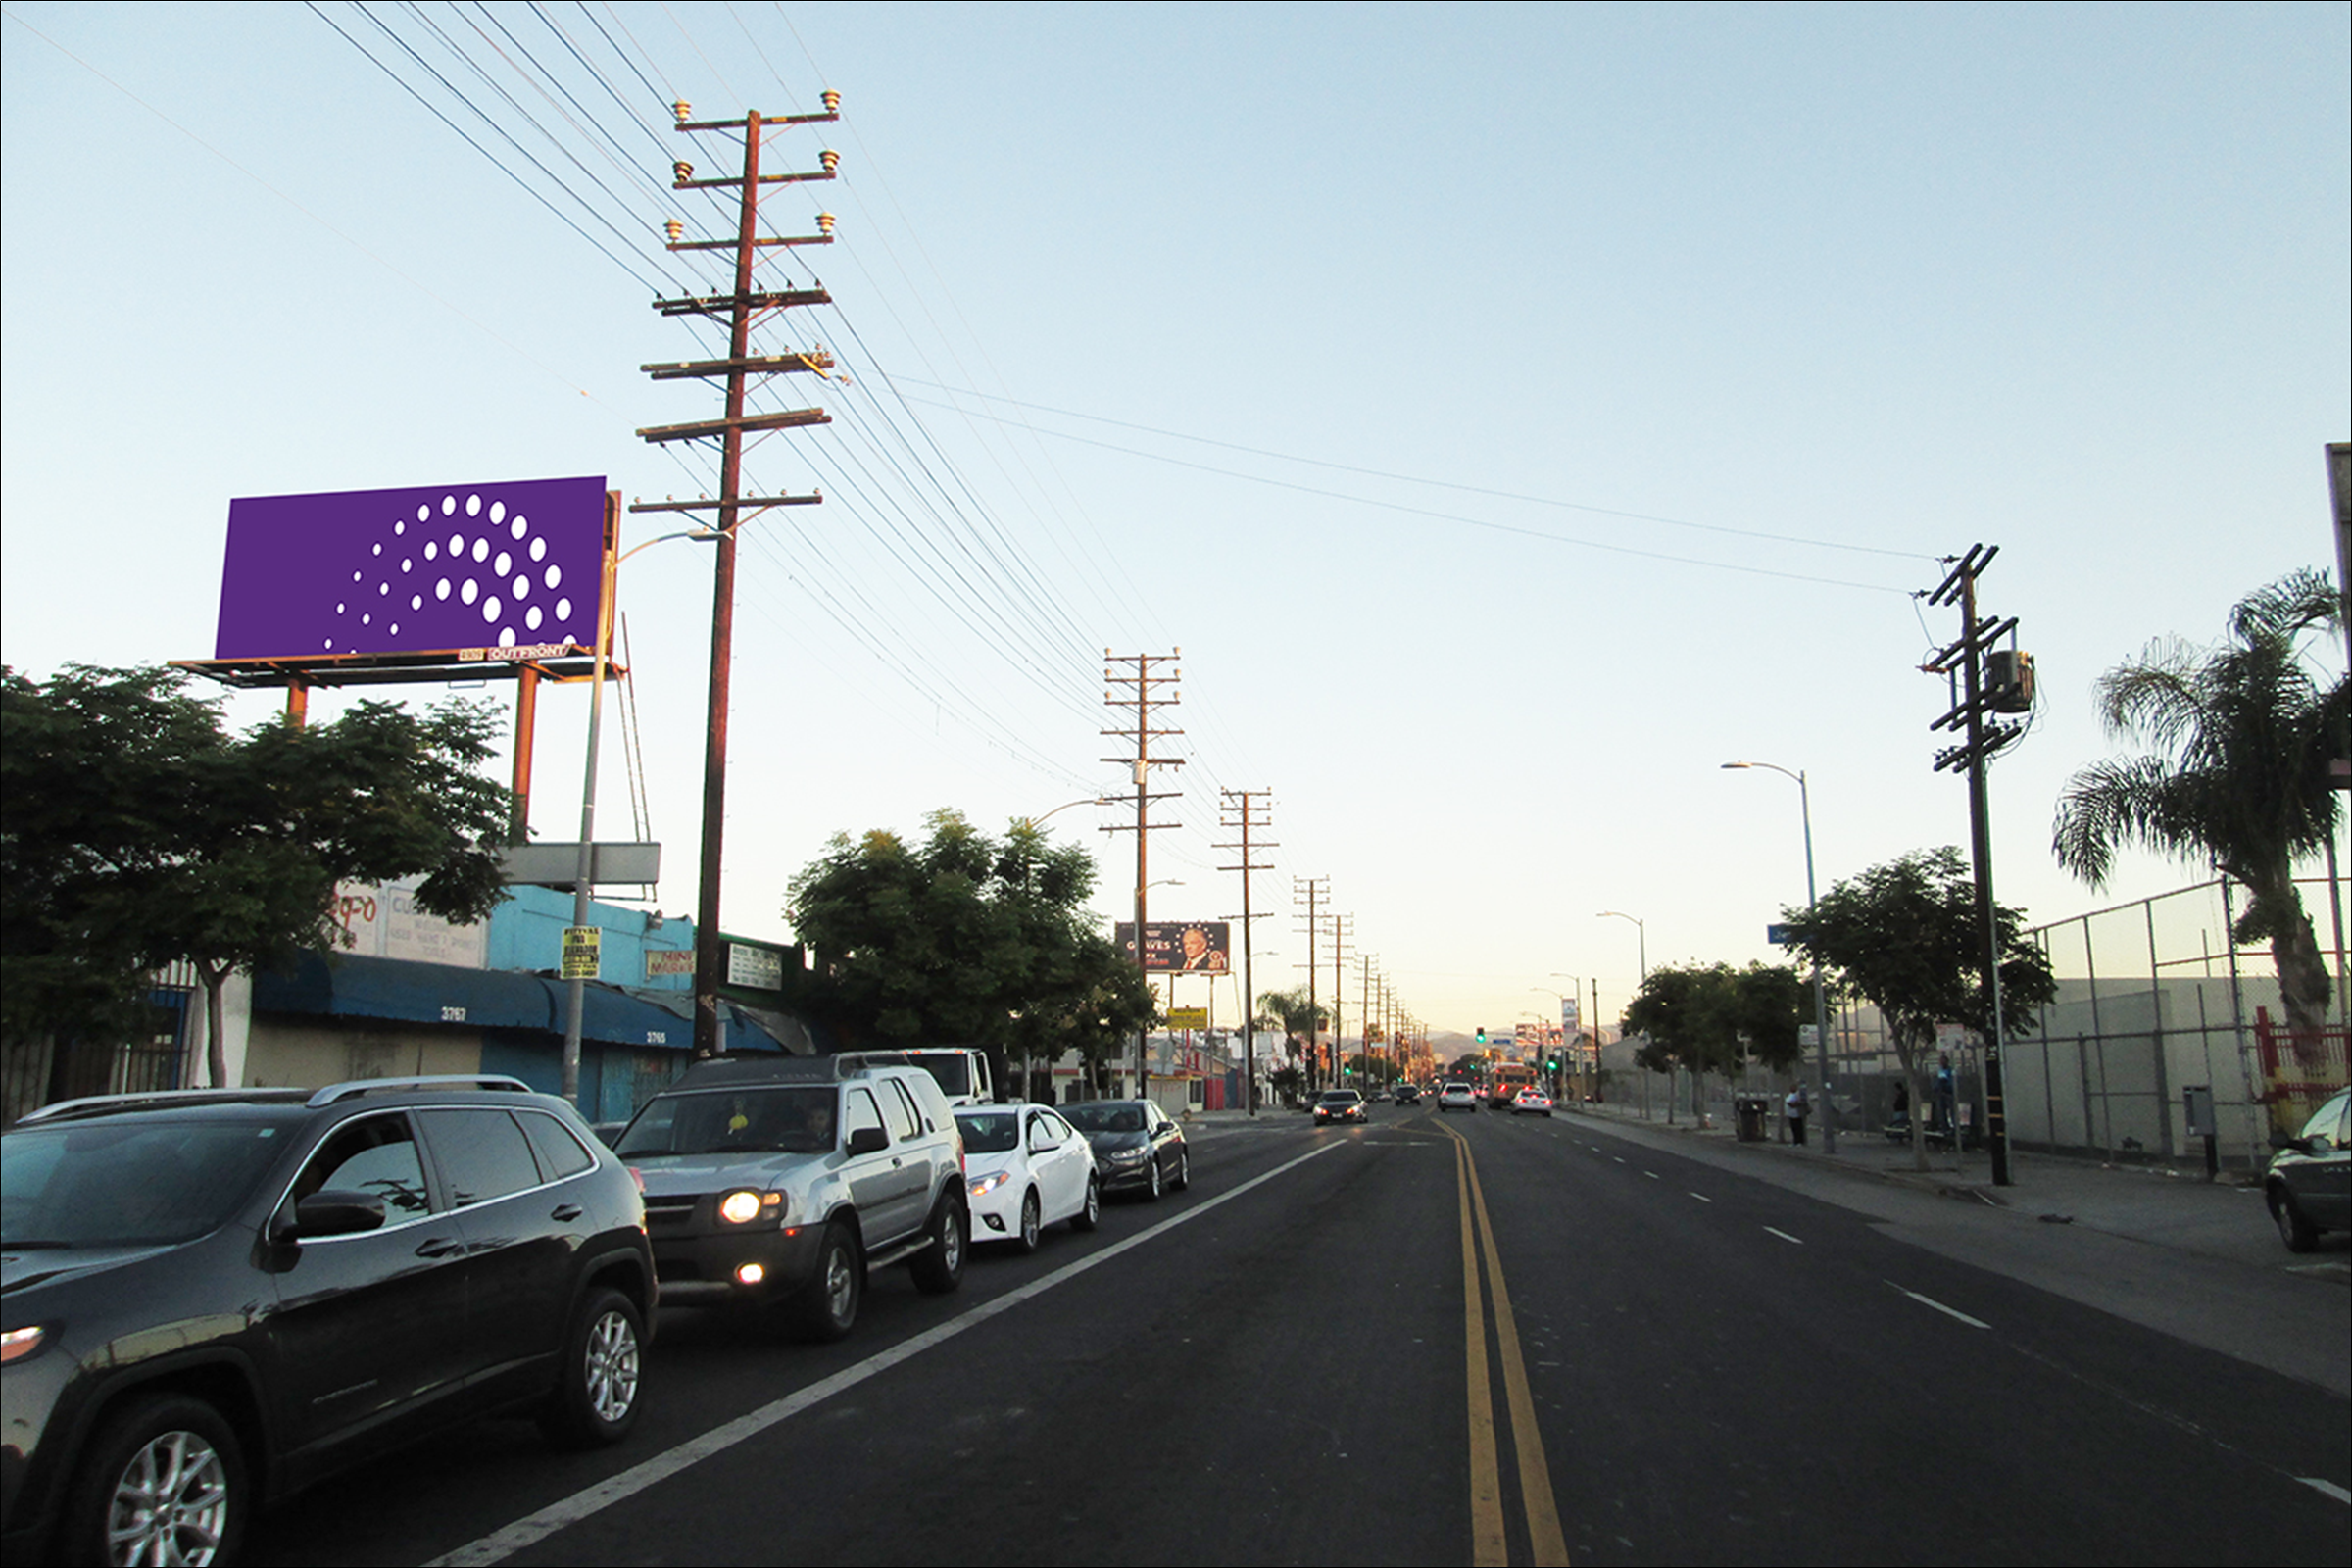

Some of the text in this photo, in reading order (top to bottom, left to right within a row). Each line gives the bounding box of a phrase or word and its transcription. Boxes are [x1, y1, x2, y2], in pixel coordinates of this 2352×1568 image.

[489, 645, 569, 660] OUTFRONT
[651, 962, 694, 974] MARKE
[442, 1006, 466, 1021] 3767
